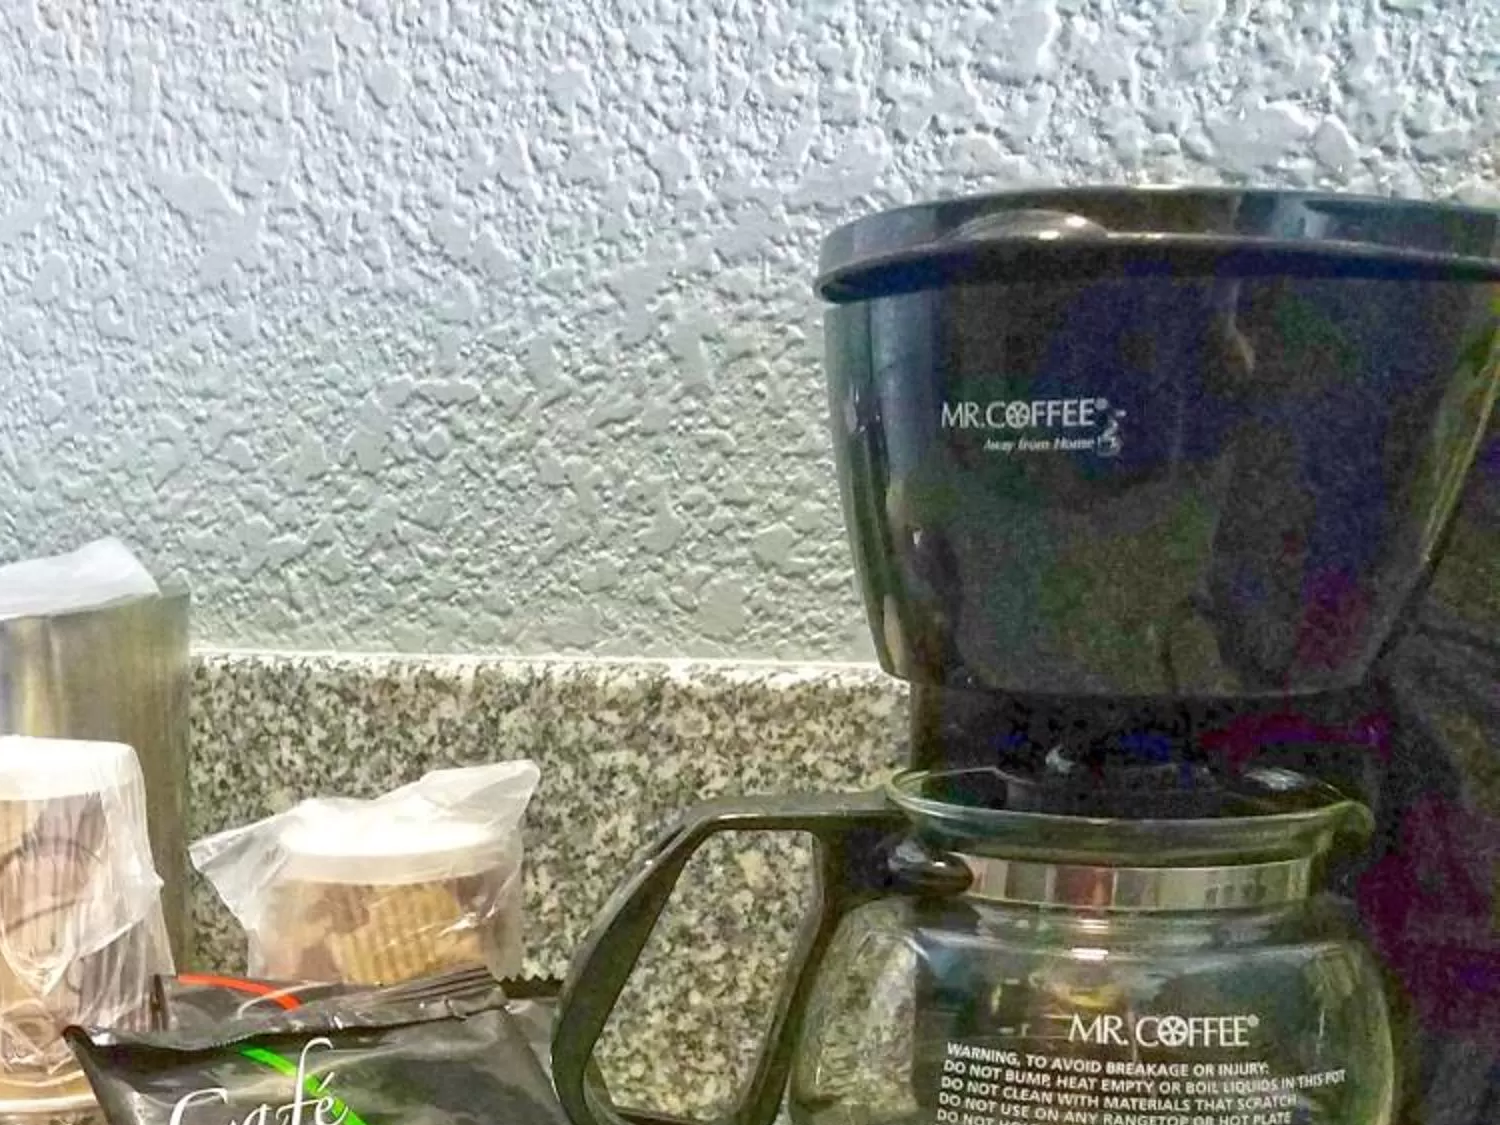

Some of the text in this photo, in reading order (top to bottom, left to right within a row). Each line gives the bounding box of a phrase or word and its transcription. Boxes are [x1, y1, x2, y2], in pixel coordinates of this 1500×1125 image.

[1053, 436, 1095, 450] Home
[1067, 1014, 1129, 1046] MR.
[943, 1059, 966, 1074] DO
[969, 1064, 1002, 1080] NOT
[1056, 1075, 1098, 1091] HEAT
[1101, 1079, 1155, 1094] EMPTY
[1159, 1081, 1181, 1095] OR
[1185, 1080, 1219, 1095] BOIL
[1223, 1079, 1278, 1095] LIQUIDS
[1281, 1076, 1295, 1090] IN
[1297, 1074, 1323, 1089] THIS
[1325, 1069, 1346, 1085] POT
[1026, 1054, 1047, 1069] TO
[1051, 1057, 1102, 1074] AVOID
[1105, 1061, 1189, 1077] BREAKAGE
[1193, 1063, 1214, 1077] OR
[939, 1091, 961, 1107] DO
[964, 1097, 998, 1113] NOT
[1001, 1103, 1031, 1118] USE
[1034, 1107, 1059, 1121] ON
[1063, 1110, 1099, 1125] ANY
[1253, 1111, 1293, 1125] PLATE
[941, 1075, 1297, 1112] DO NOT CLEAN WITH MATERIALS THAT SCRATCH
[936, 1109, 959, 1124] DO
